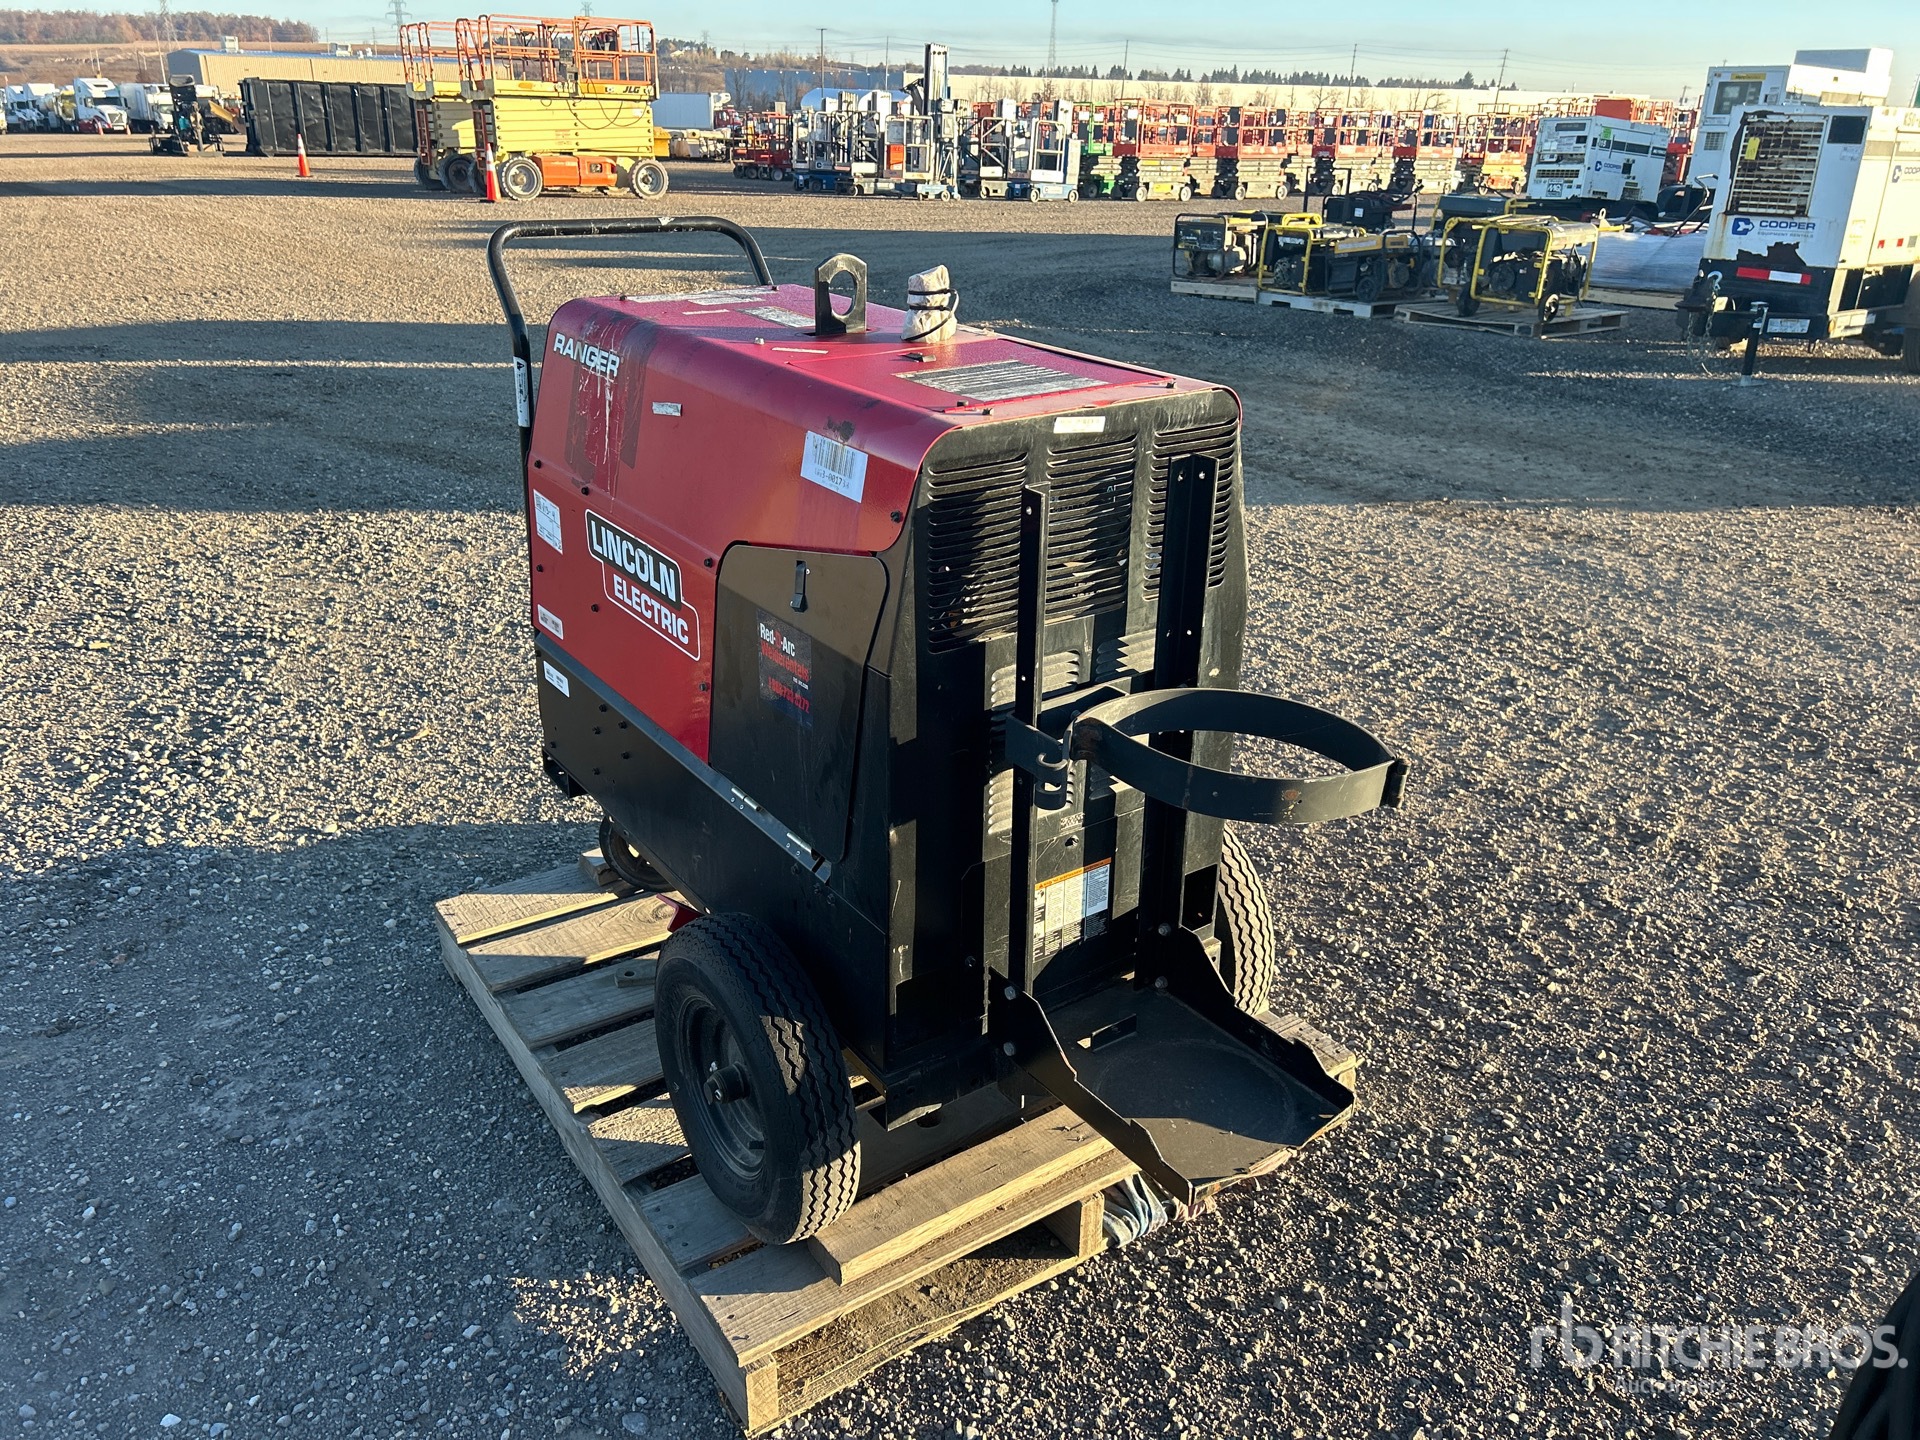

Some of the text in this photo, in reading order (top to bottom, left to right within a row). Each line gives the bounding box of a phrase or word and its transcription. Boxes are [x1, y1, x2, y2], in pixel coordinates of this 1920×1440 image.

[1759, 220, 1816, 231] COOPER
[553, 332, 620, 377] RANGER
[591, 520, 676, 602] LINCOLN
[613, 573, 689, 645] ELECTRIC
[760, 622, 796, 657] Red-D-Arc
